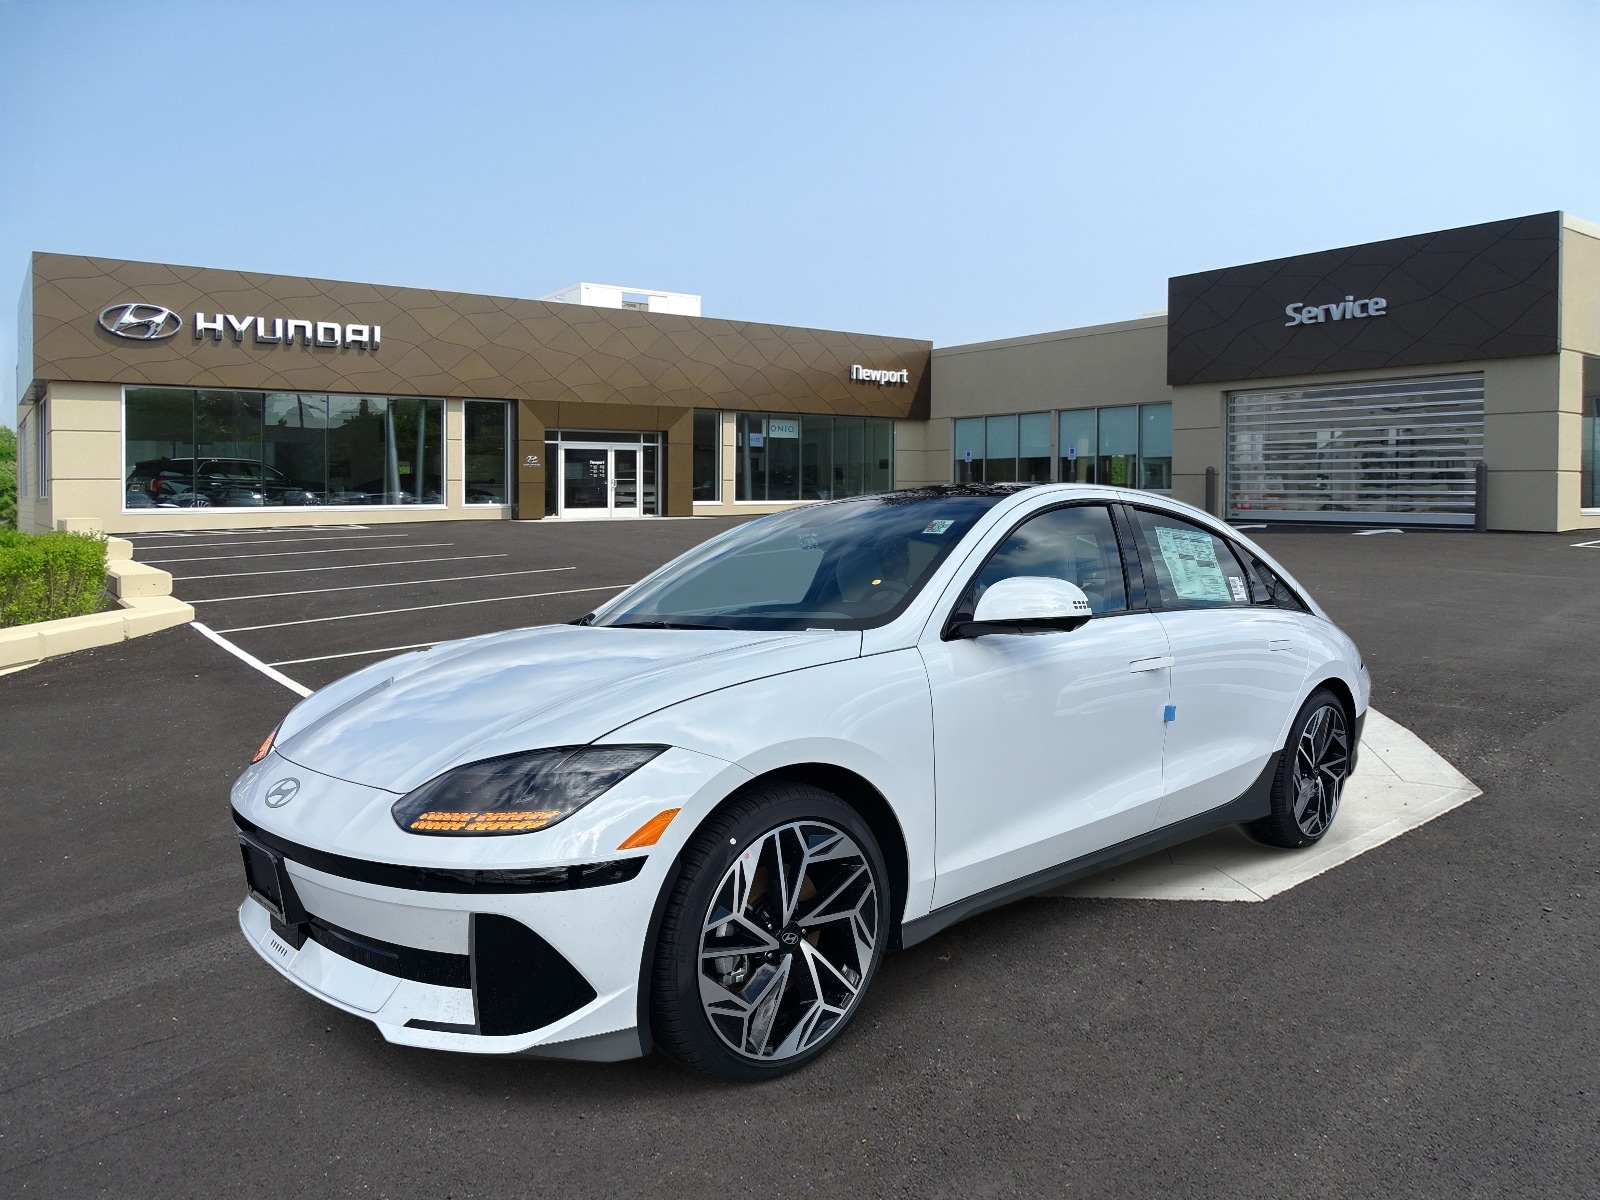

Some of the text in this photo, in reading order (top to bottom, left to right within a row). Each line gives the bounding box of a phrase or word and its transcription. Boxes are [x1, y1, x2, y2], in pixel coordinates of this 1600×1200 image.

[1285, 295, 1387, 327] Service
[195, 312, 381, 350] HYUNDAI
[850, 364, 909, 385] Newport
[769, 424, 795, 433] ONIQ
